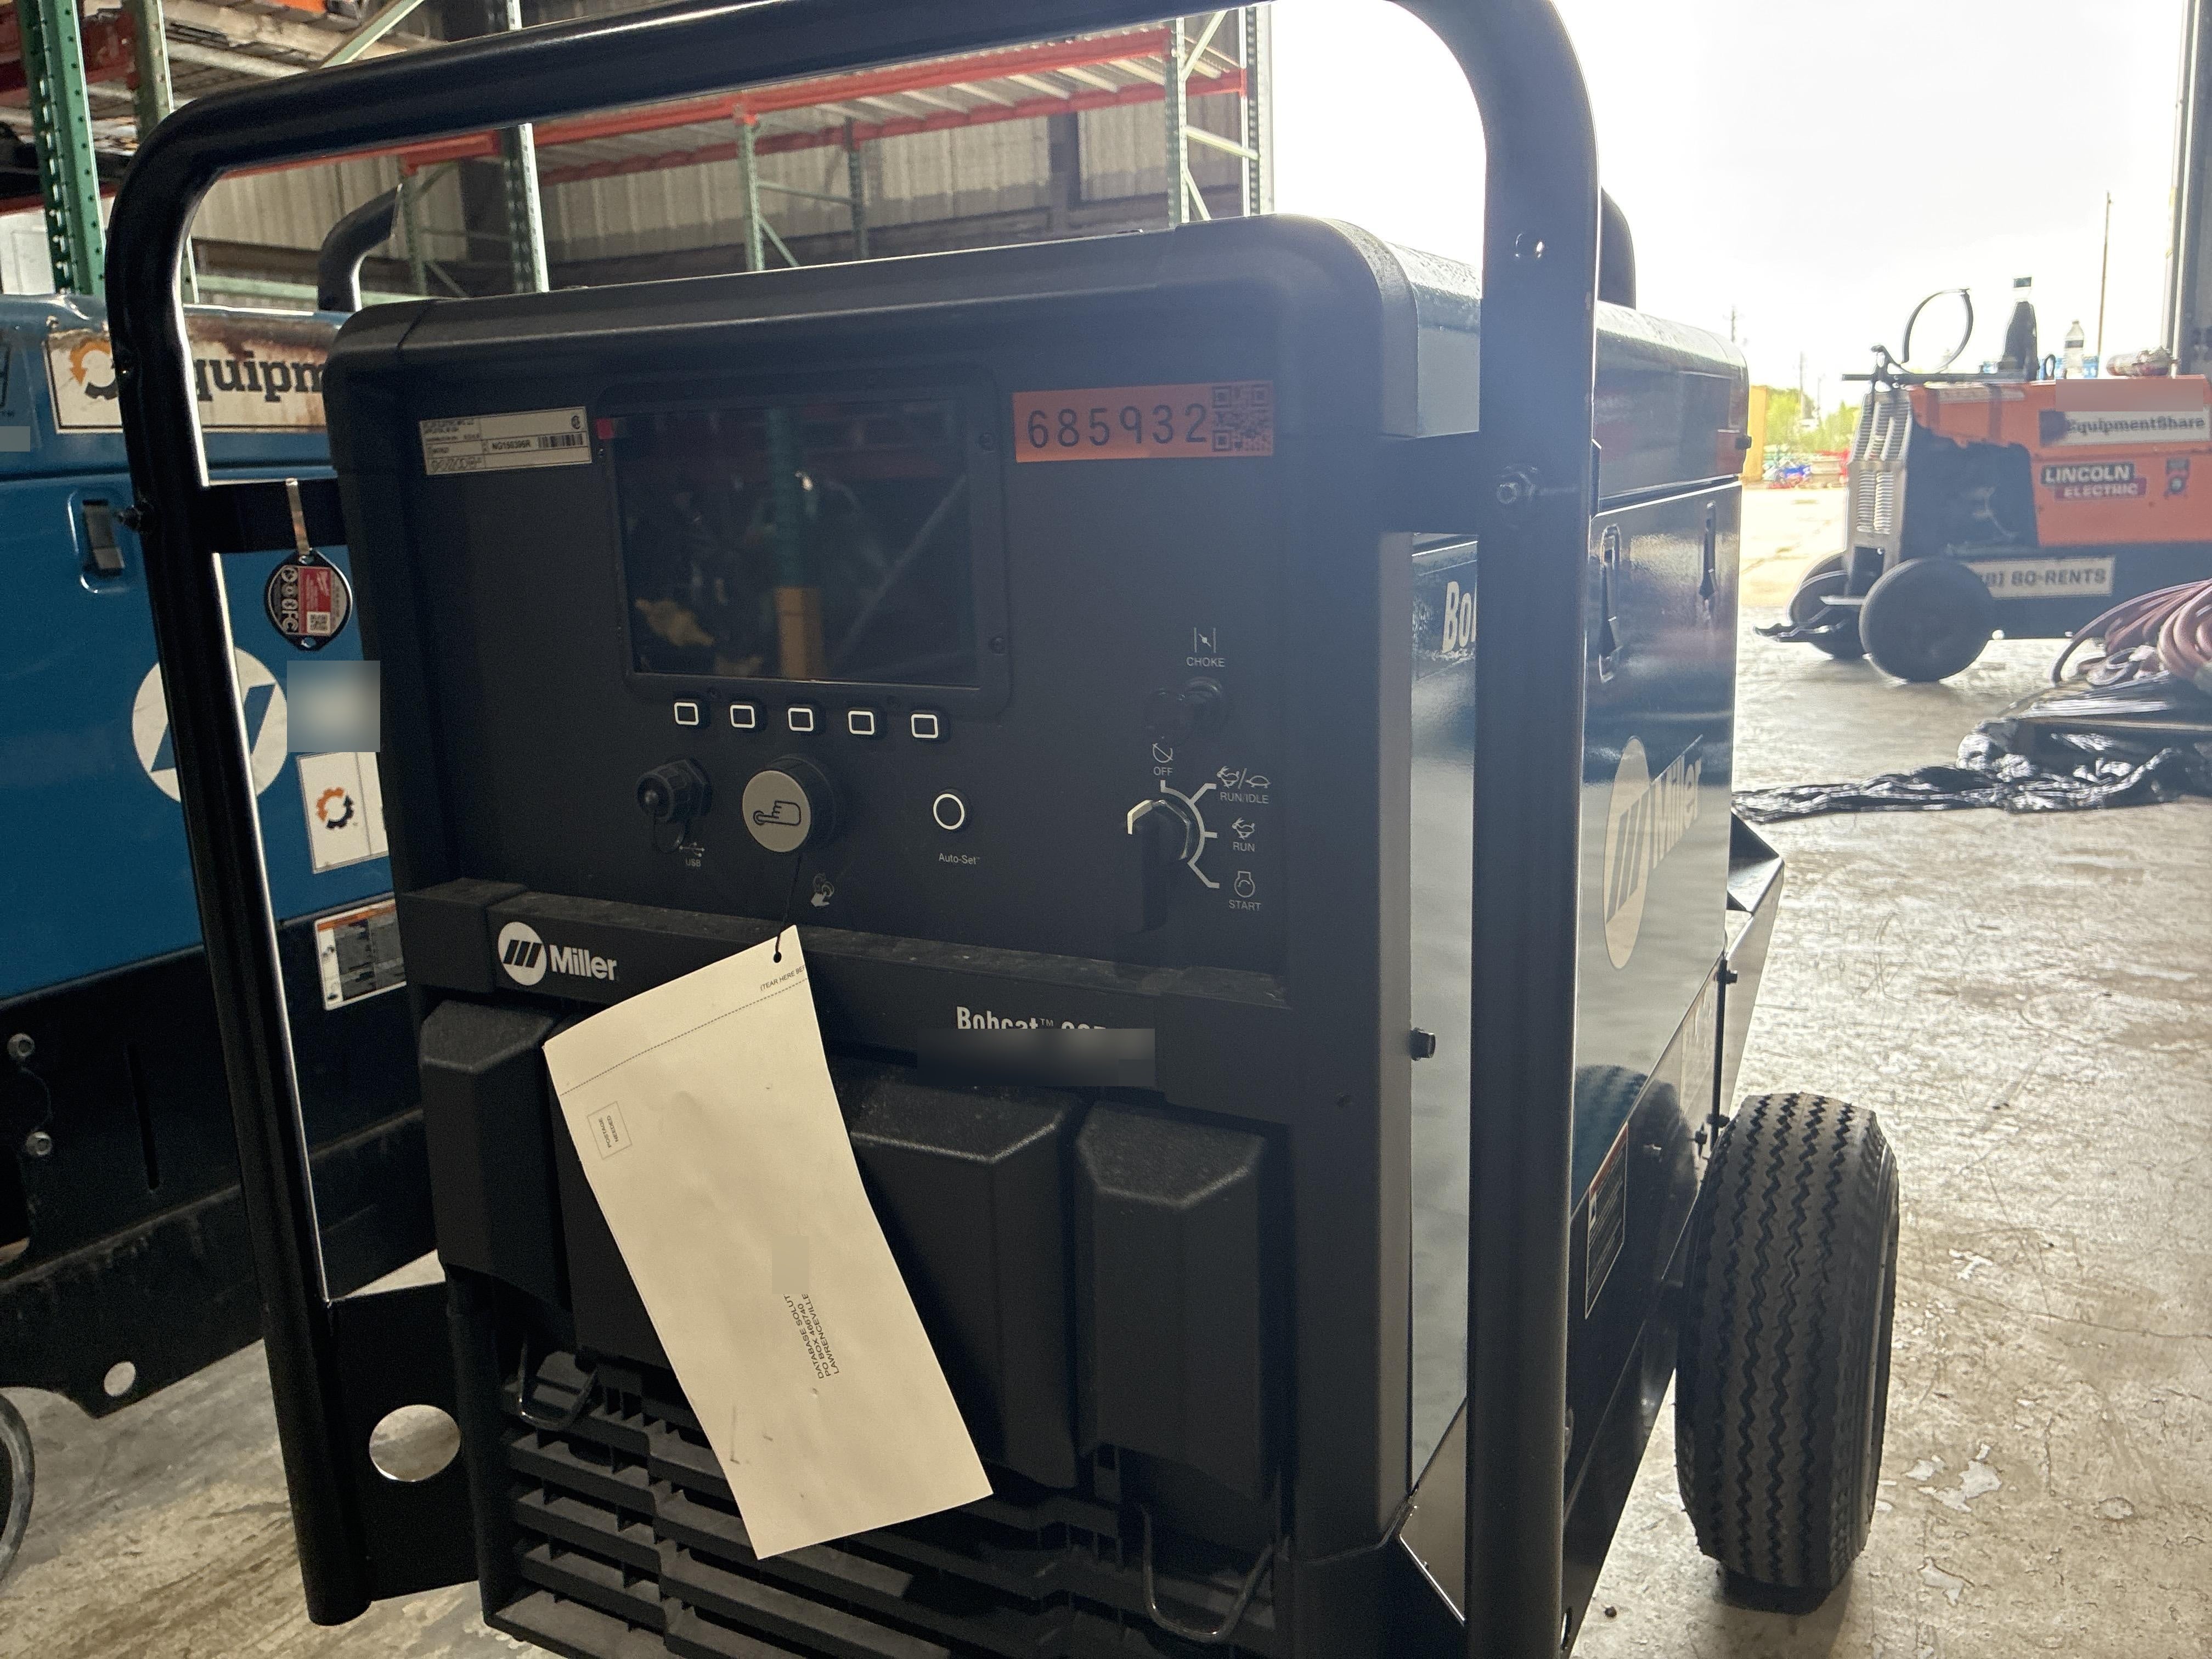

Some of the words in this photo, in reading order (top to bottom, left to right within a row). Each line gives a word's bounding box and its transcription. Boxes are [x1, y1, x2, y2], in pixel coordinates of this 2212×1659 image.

[1028, 403, 1207, 449] 685932
[2044, 464, 2130, 484] LINCOLN
[2063, 483, 2138, 498] ELECTRIC
[1186, 656, 1227, 669] CHOKE
[1153, 766, 1173, 777] OFF
[1652, 756, 1701, 870] Miller
[1232, 841, 1256, 852] RUN
[685, 858, 702, 867] USB
[1228, 899, 1262, 912] START
[549, 944, 617, 981] Miller
[779, 970, 795, 983] HERE
[598, 1117, 612, 1148] POSTAGE
[606, 1115, 619, 1142] NEEDED
[798, 1303, 815, 1336] 466740
[801, 1294, 840, 1375] LAWRENCEVILLE
[799, 1328, 824, 1379] DATABASE
[812, 1337, 825, 1360] BOX
[822, 1362, 831, 1376] PO
